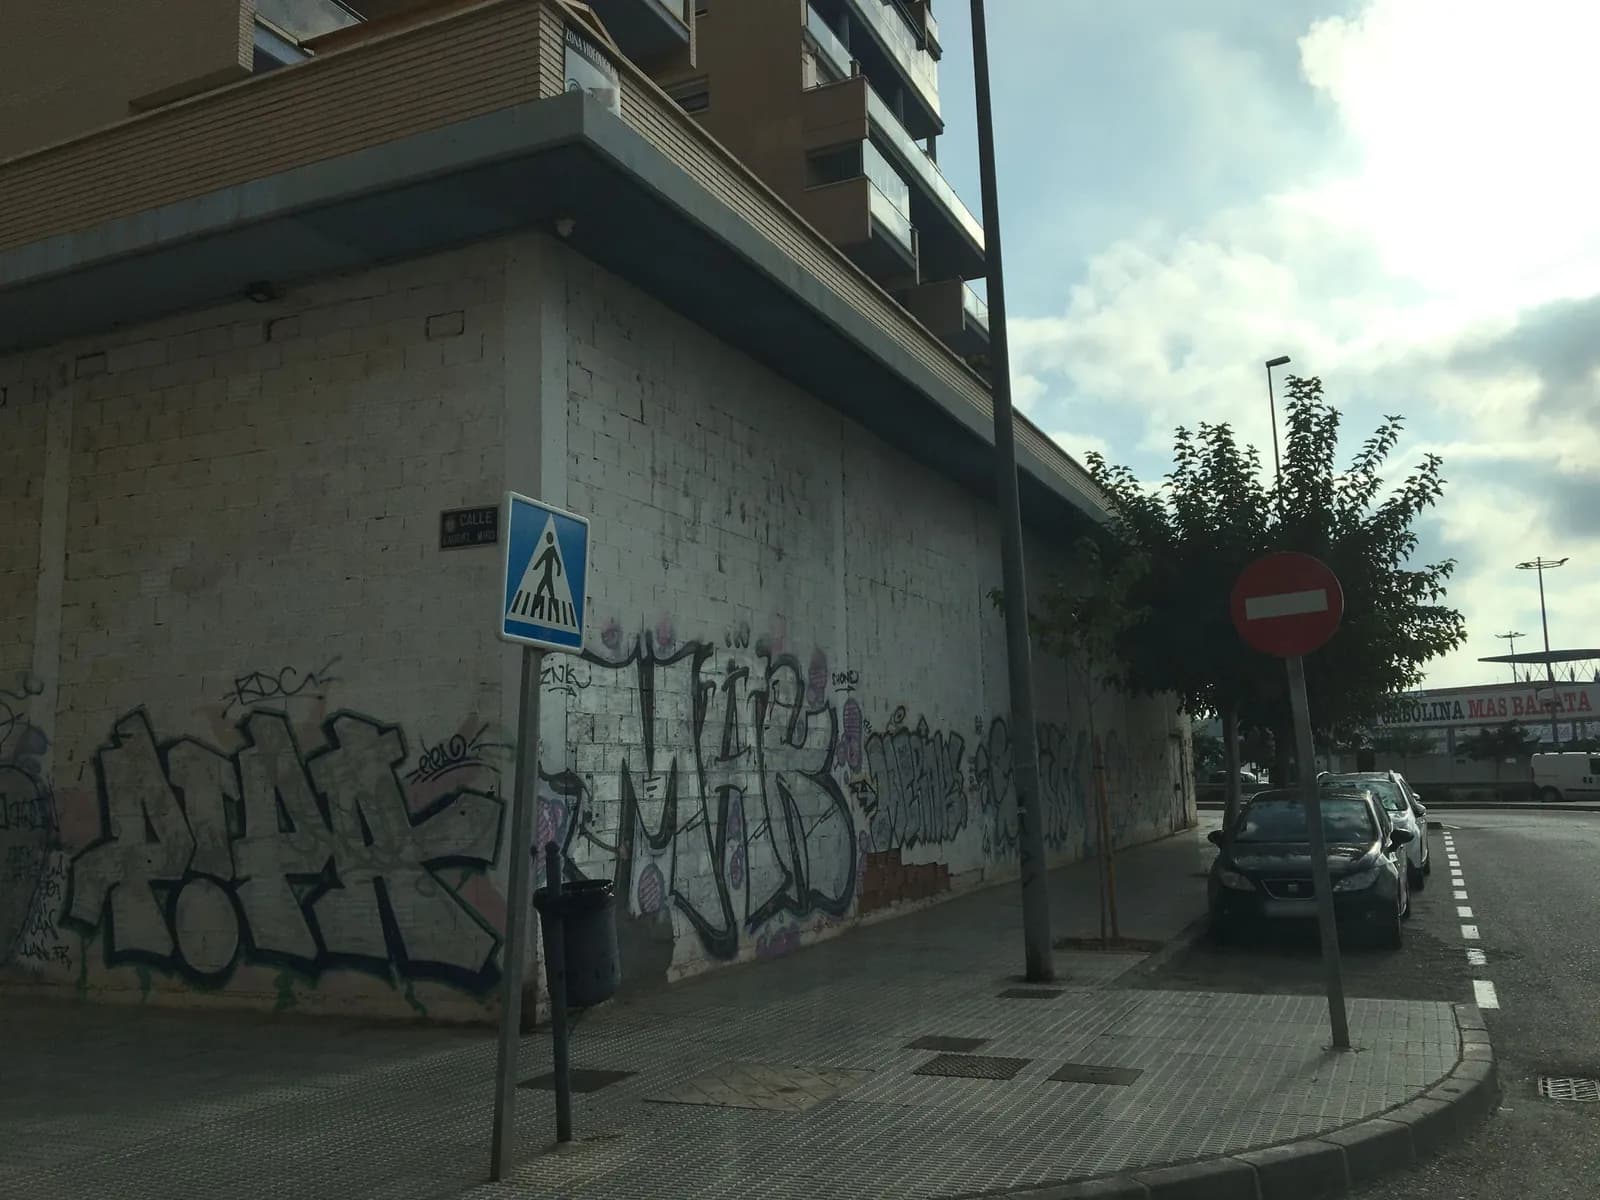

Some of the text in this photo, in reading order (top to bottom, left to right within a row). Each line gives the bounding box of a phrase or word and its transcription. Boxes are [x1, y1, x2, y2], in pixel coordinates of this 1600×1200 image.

[565, 26, 583, 51] ZONA
[459, 511, 493, 527] CALLE
[1467, 697, 1508, 719] MAS
